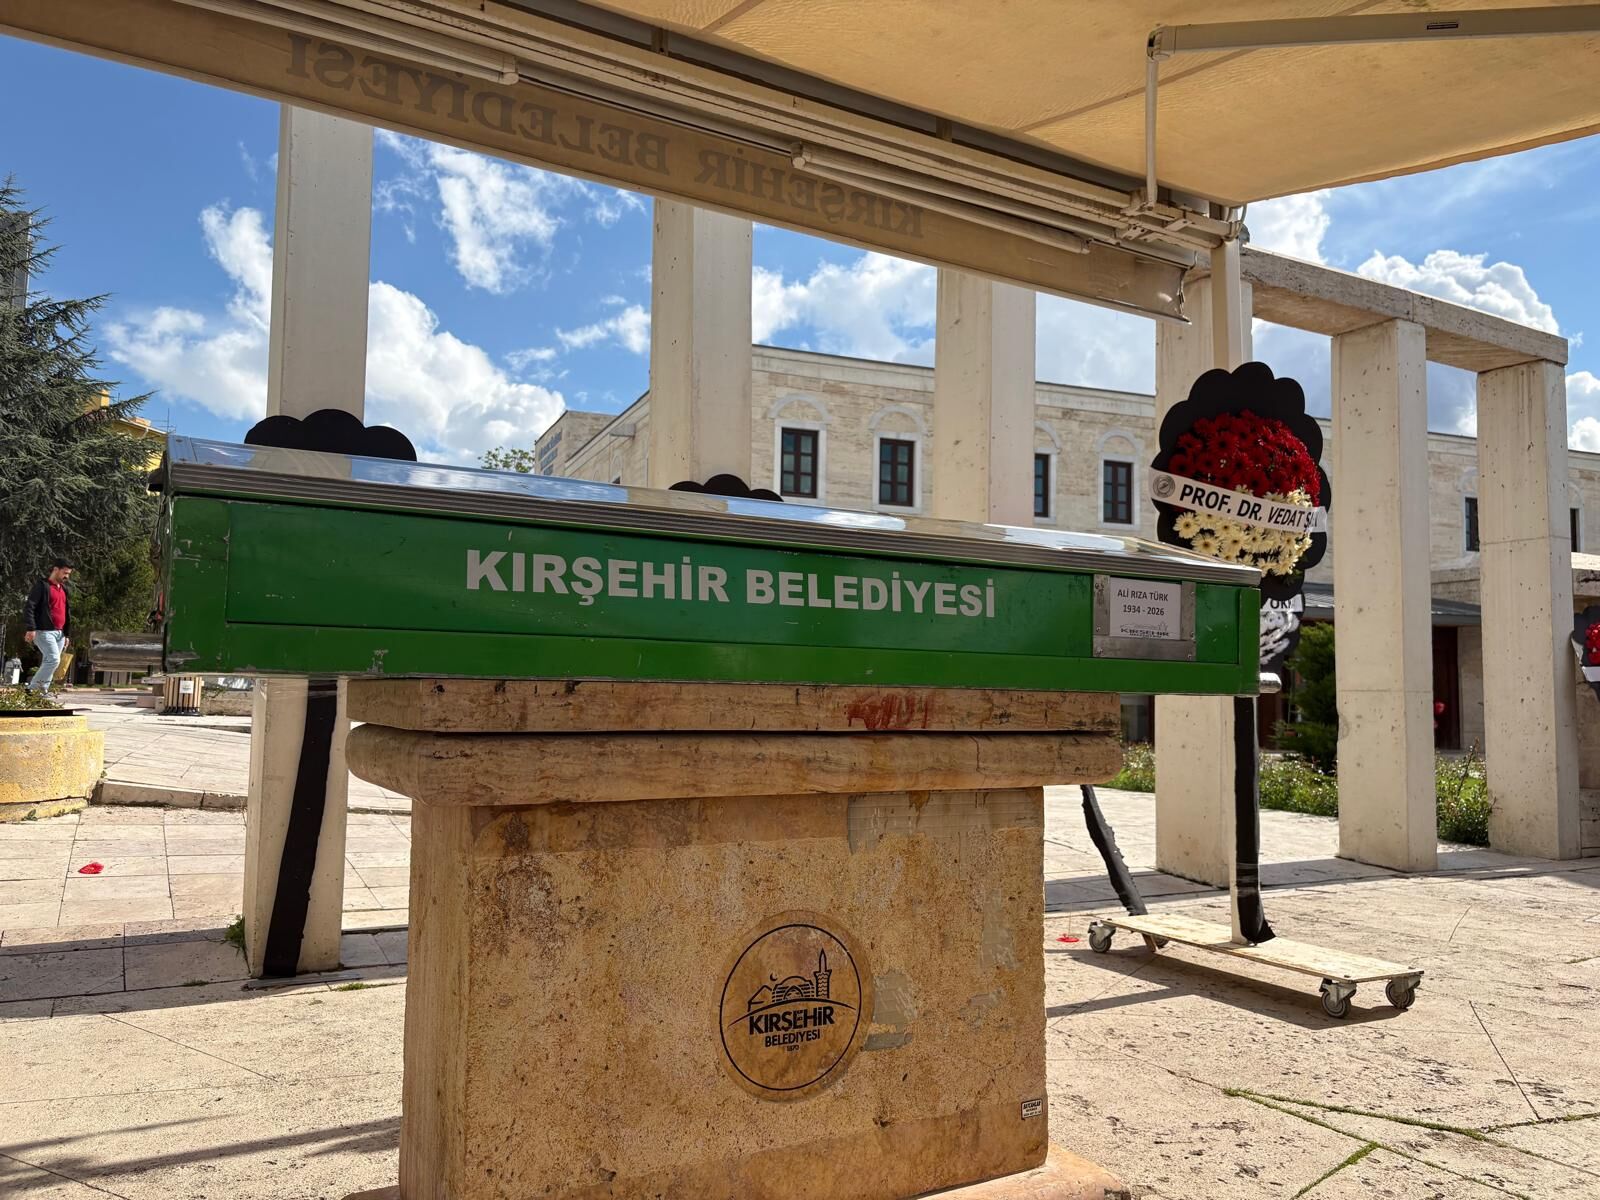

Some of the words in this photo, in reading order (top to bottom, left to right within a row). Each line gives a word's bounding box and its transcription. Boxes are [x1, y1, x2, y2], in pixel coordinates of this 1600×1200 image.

[1180, 484, 1231, 513] PROF.
[1237, 500, 1262, 521] DR.
[1268, 506, 1305, 527] VEDAT
[466, 549, 730, 606] KIRŞEHİR
[746, 569, 995, 618] BELEDİYESİ
[1117, 588, 1128, 598] ALİ
[1131, 590, 1147, 600] RIZA
[1150, 591, 1168, 601] TÜRK
[1123, 604, 1140, 613] 1934
[1147, 606, 1165, 616] 2026
